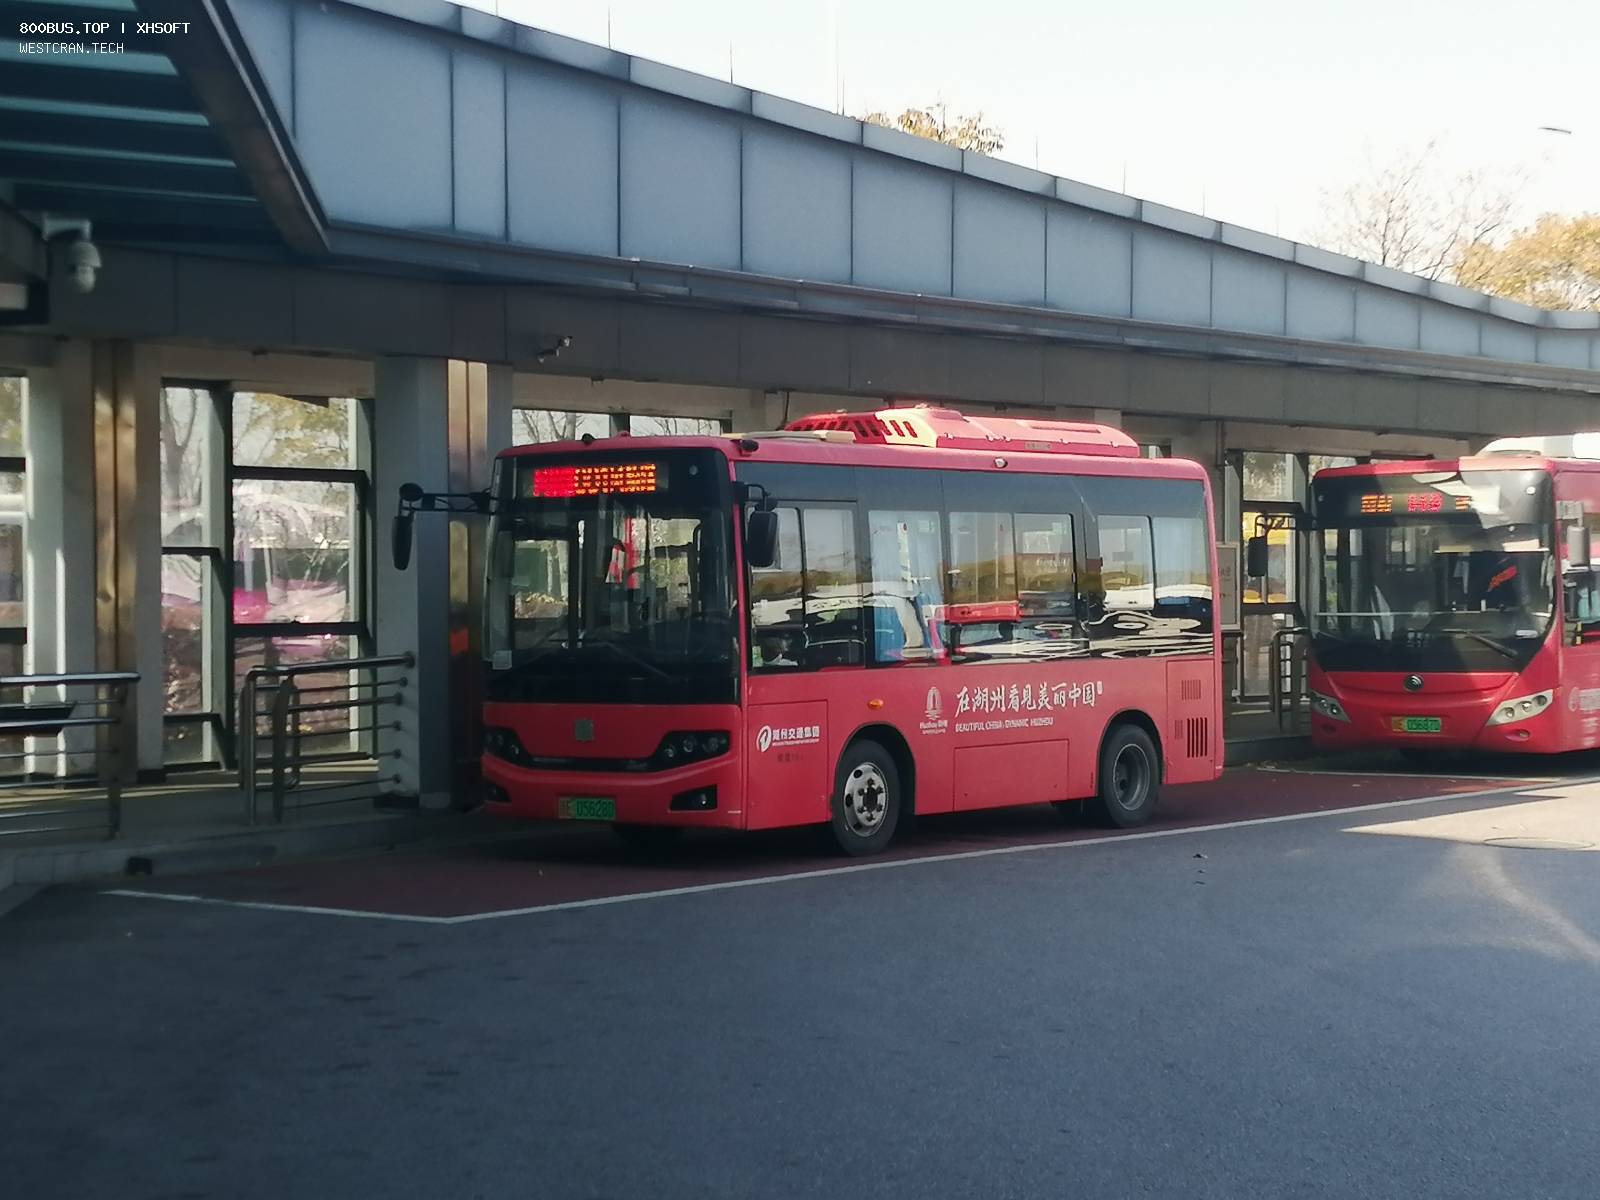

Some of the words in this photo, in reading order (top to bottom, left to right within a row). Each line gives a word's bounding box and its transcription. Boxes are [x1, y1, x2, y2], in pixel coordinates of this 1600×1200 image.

[954, 681, 1096, 718] 在湖州看见美丽中国
